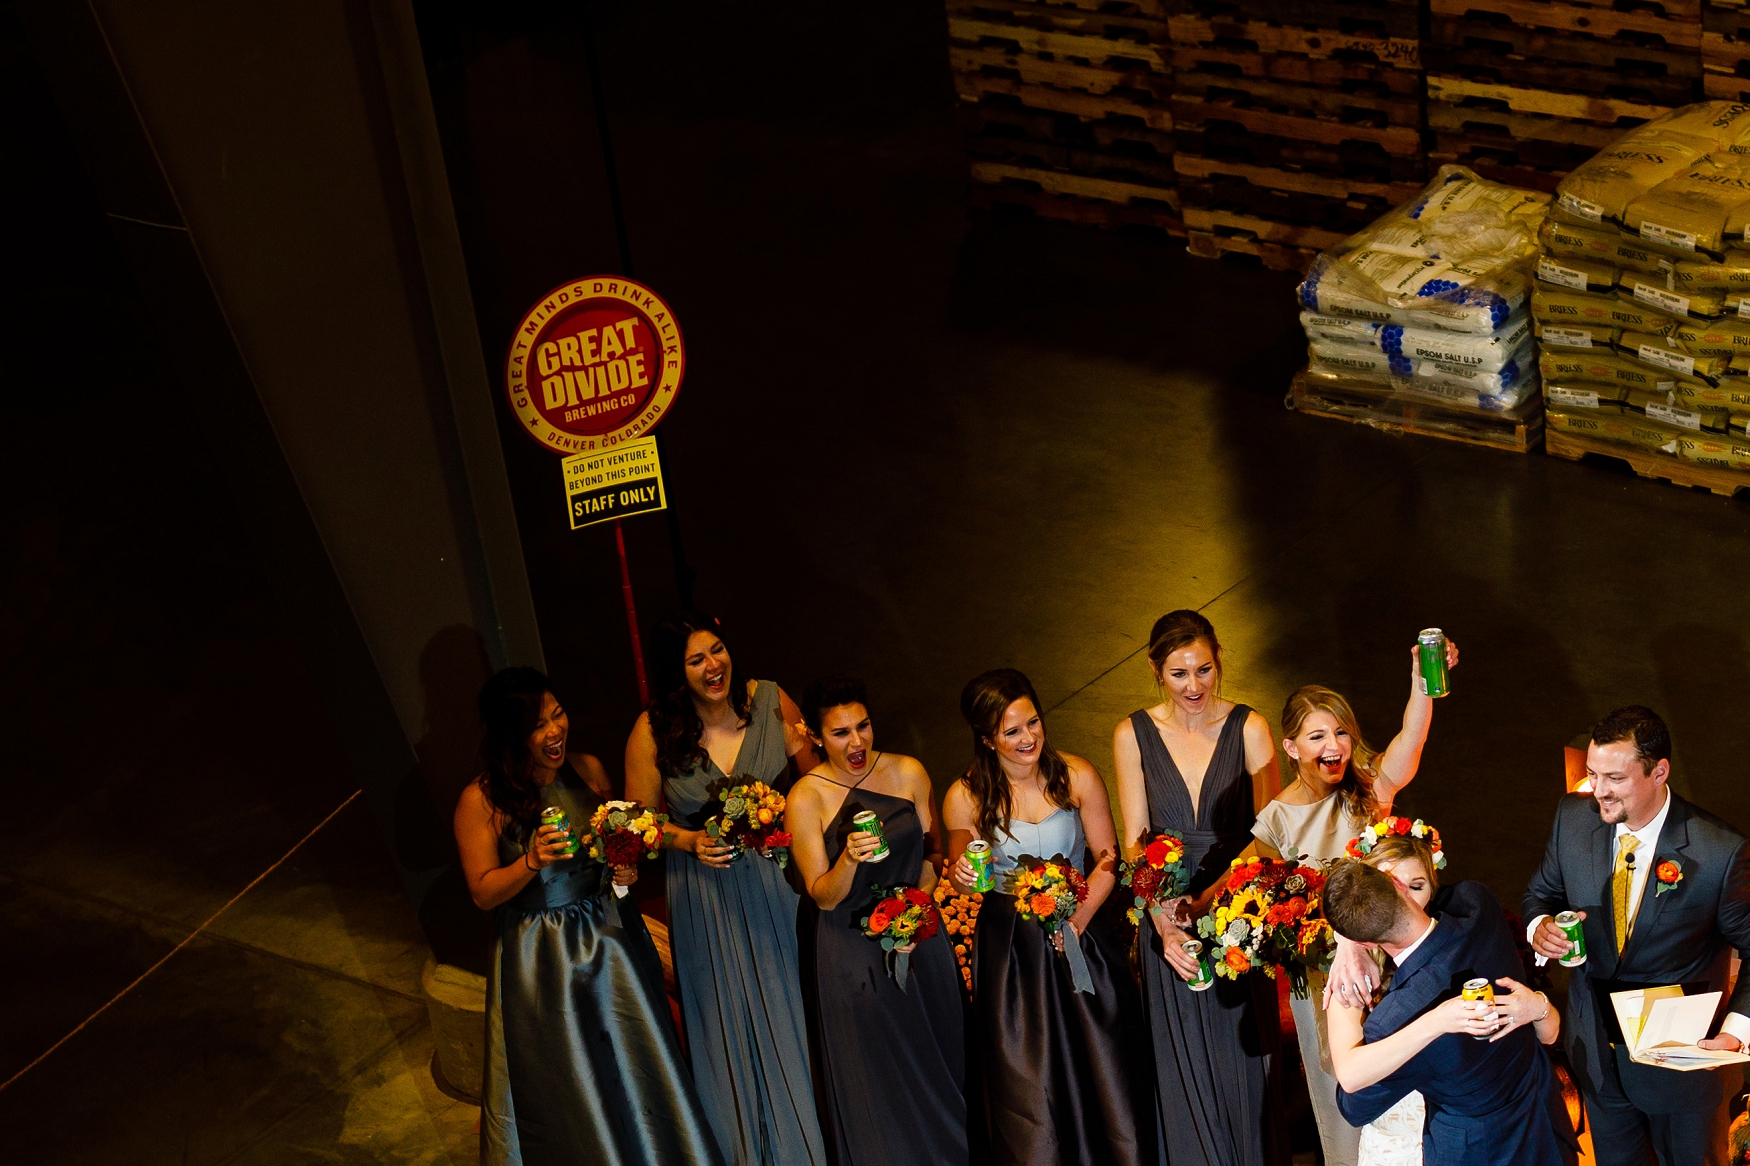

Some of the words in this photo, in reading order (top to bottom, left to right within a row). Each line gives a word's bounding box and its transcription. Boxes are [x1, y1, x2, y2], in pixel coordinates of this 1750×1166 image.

[1555, 234, 1583, 246] BRIESS
[1617, 247, 1648, 262] BRIESS
[1549, 304, 1578, 315] BRIESS
[1612, 311, 1643, 324] BRIESS
[512, 340, 528, 409] GREAT
[525, 286, 584, 336] MINDS
[593, 282, 655, 310] DRINK
[654, 311, 678, 369] ALIKE
[536, 316, 640, 378] GREAT
[1416, 348, 1443, 360] EPSOM
[1444, 353, 1461, 363] SALT
[1464, 356, 1483, 365] U.S.P
[1556, 364, 1583, 373] BRIESS
[1616, 369, 1647, 383] BRIESS
[541, 352, 649, 411] DIVIDE
[564, 398, 619, 423] BREWING
[620, 393, 636, 408] CO
[547, 431, 595, 450] DENVER
[601, 403, 662, 448] COLORADO
[1568, 418, 1598, 429] BRIESS
[573, 465, 585, 475] DO
[587, 458, 605, 471] NOT
[606, 449, 648, 466] VENTURE
[568, 473, 604, 491] BEYOND
[605, 468, 627, 482] THIS
[628, 462, 656, 477] POINT
[574, 493, 615, 517] STAFF
[619, 485, 656, 506] ONLY
